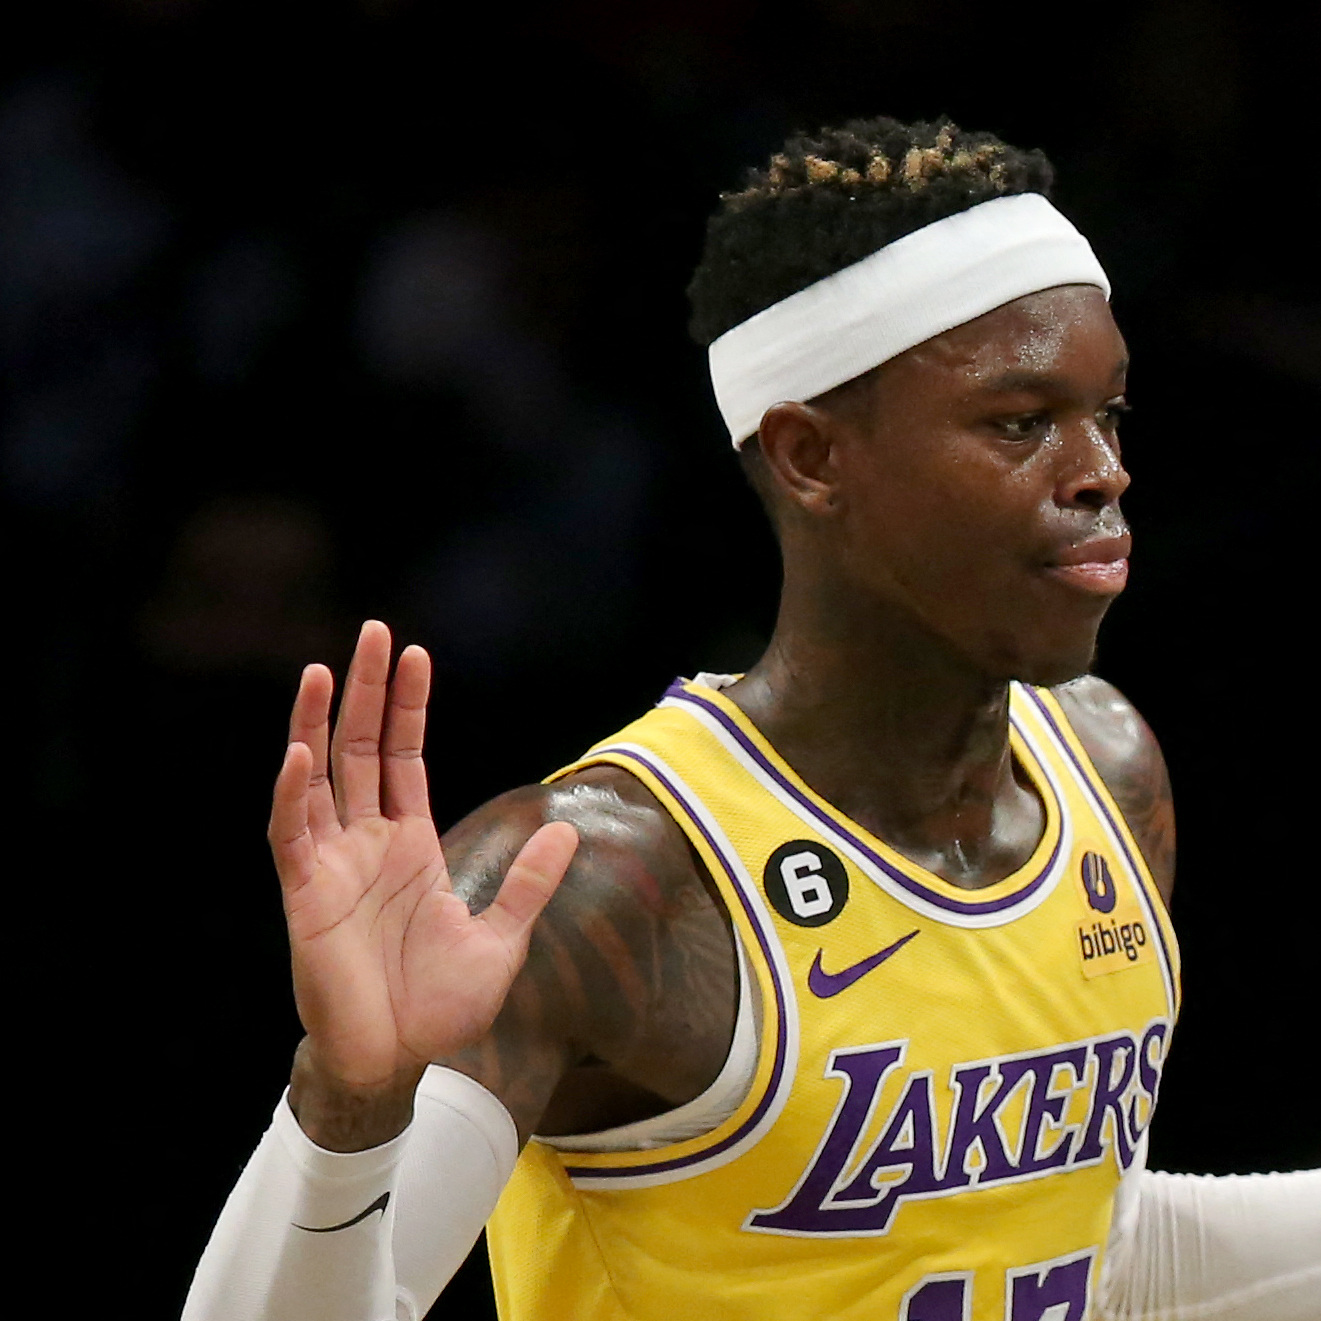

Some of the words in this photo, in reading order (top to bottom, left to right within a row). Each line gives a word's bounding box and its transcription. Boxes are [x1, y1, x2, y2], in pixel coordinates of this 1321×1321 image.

[778, 851, 835, 919] 6
[1078, 918, 1146, 962] bibigo
[741, 1016, 1174, 1238] LAKERS
